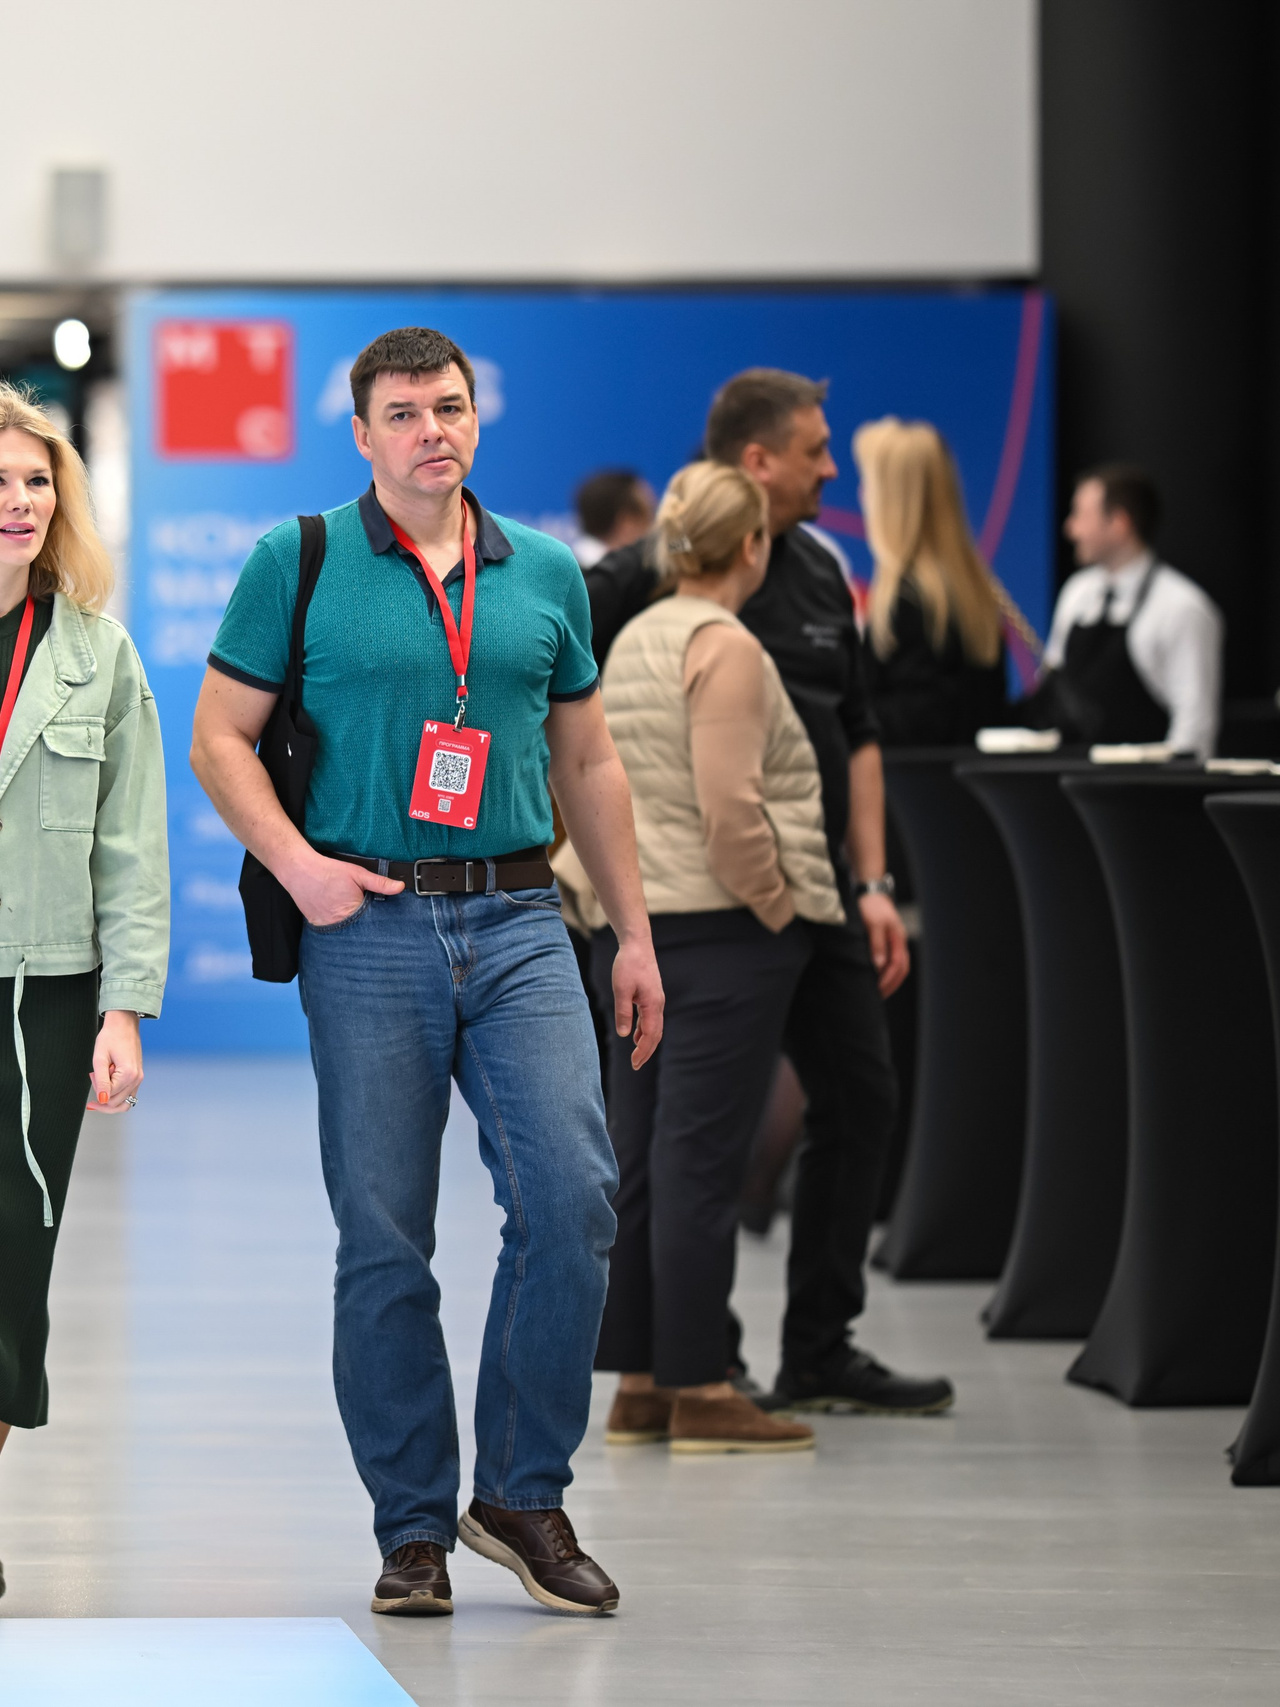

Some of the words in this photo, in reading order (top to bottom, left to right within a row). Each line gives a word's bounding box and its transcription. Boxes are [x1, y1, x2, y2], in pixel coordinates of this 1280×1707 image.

[425, 723, 438, 734] М
[478, 733, 488, 744] Т
[438, 740, 471, 751] ПРОГРАММА
[411, 809, 430, 819] ADS
[463, 817, 474, 827] С
